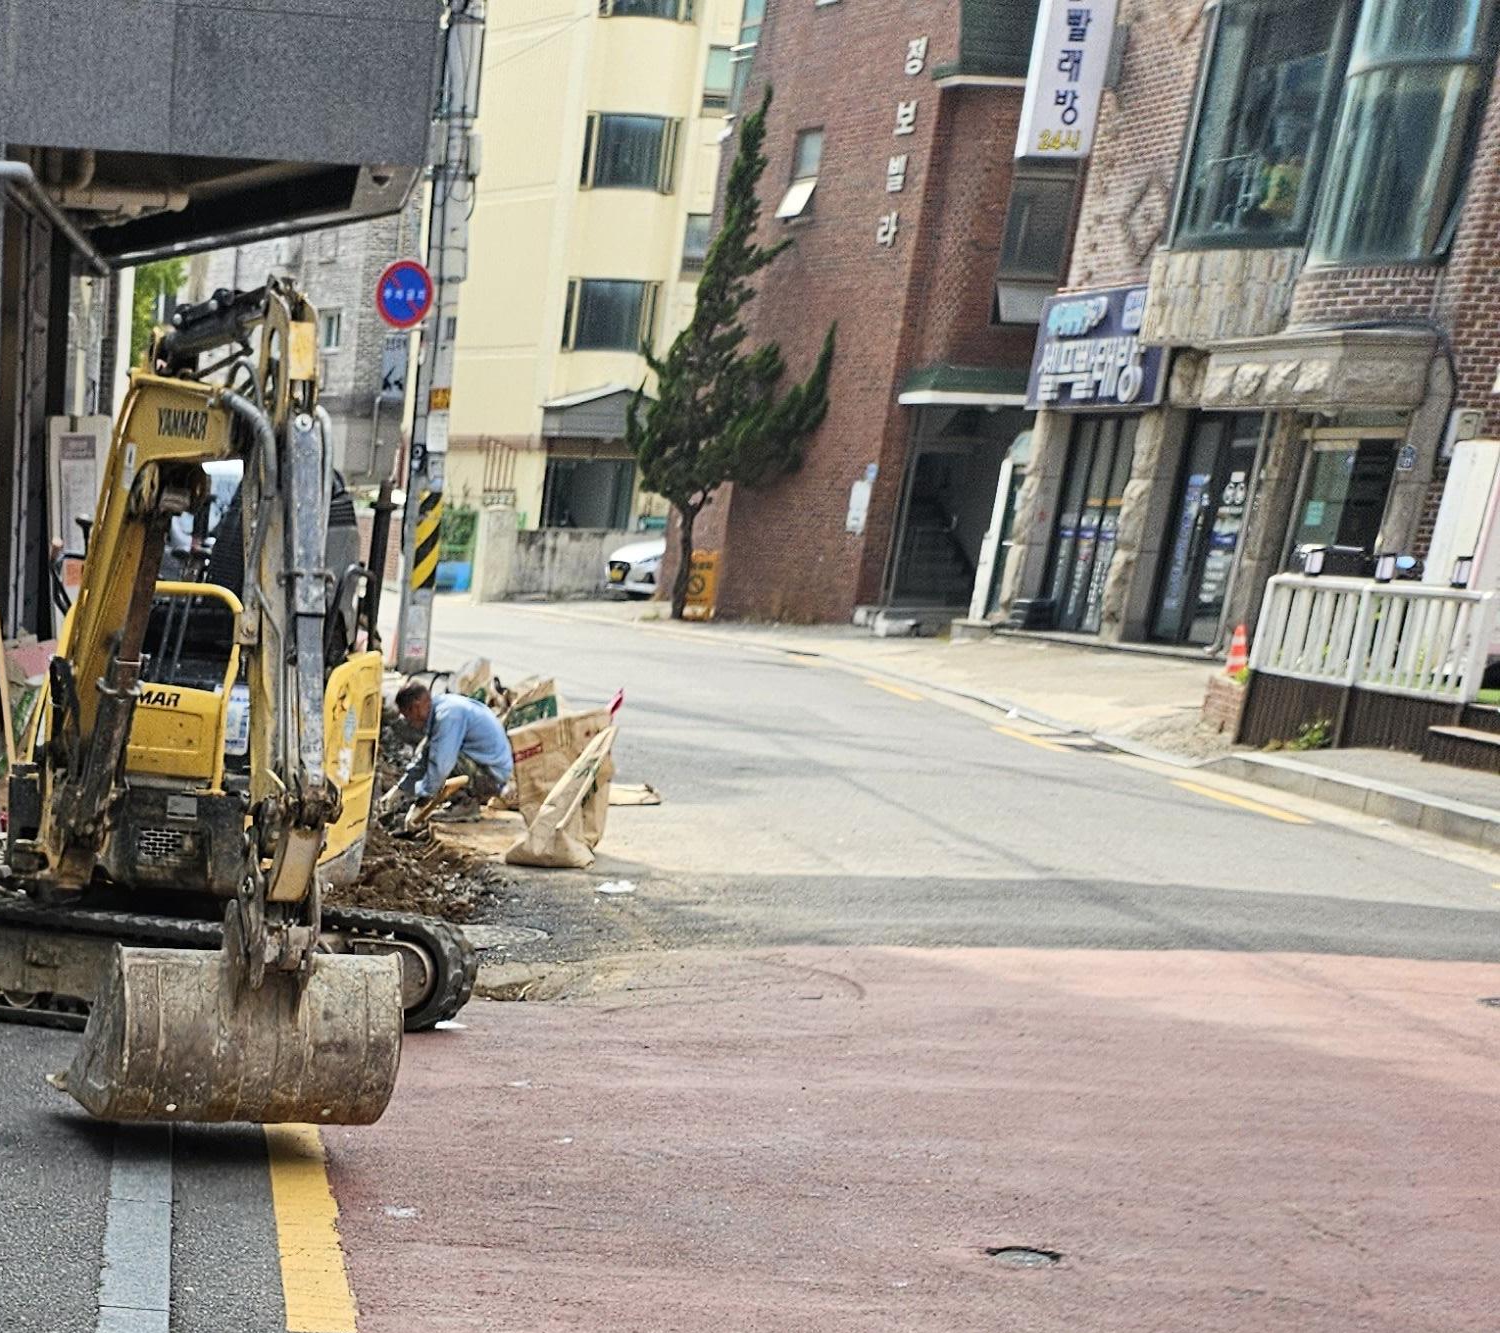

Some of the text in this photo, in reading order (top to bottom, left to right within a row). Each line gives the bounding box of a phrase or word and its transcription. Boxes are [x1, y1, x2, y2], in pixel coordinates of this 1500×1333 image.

[1054, 0, 1092, 126] 빨래방
[876, 35, 929, 248] 정보빌라
[1037, 336, 1146, 403] 셀프빨래방
[158, 407, 208, 441] YANMAR
[140, 690, 181, 707] MAR
